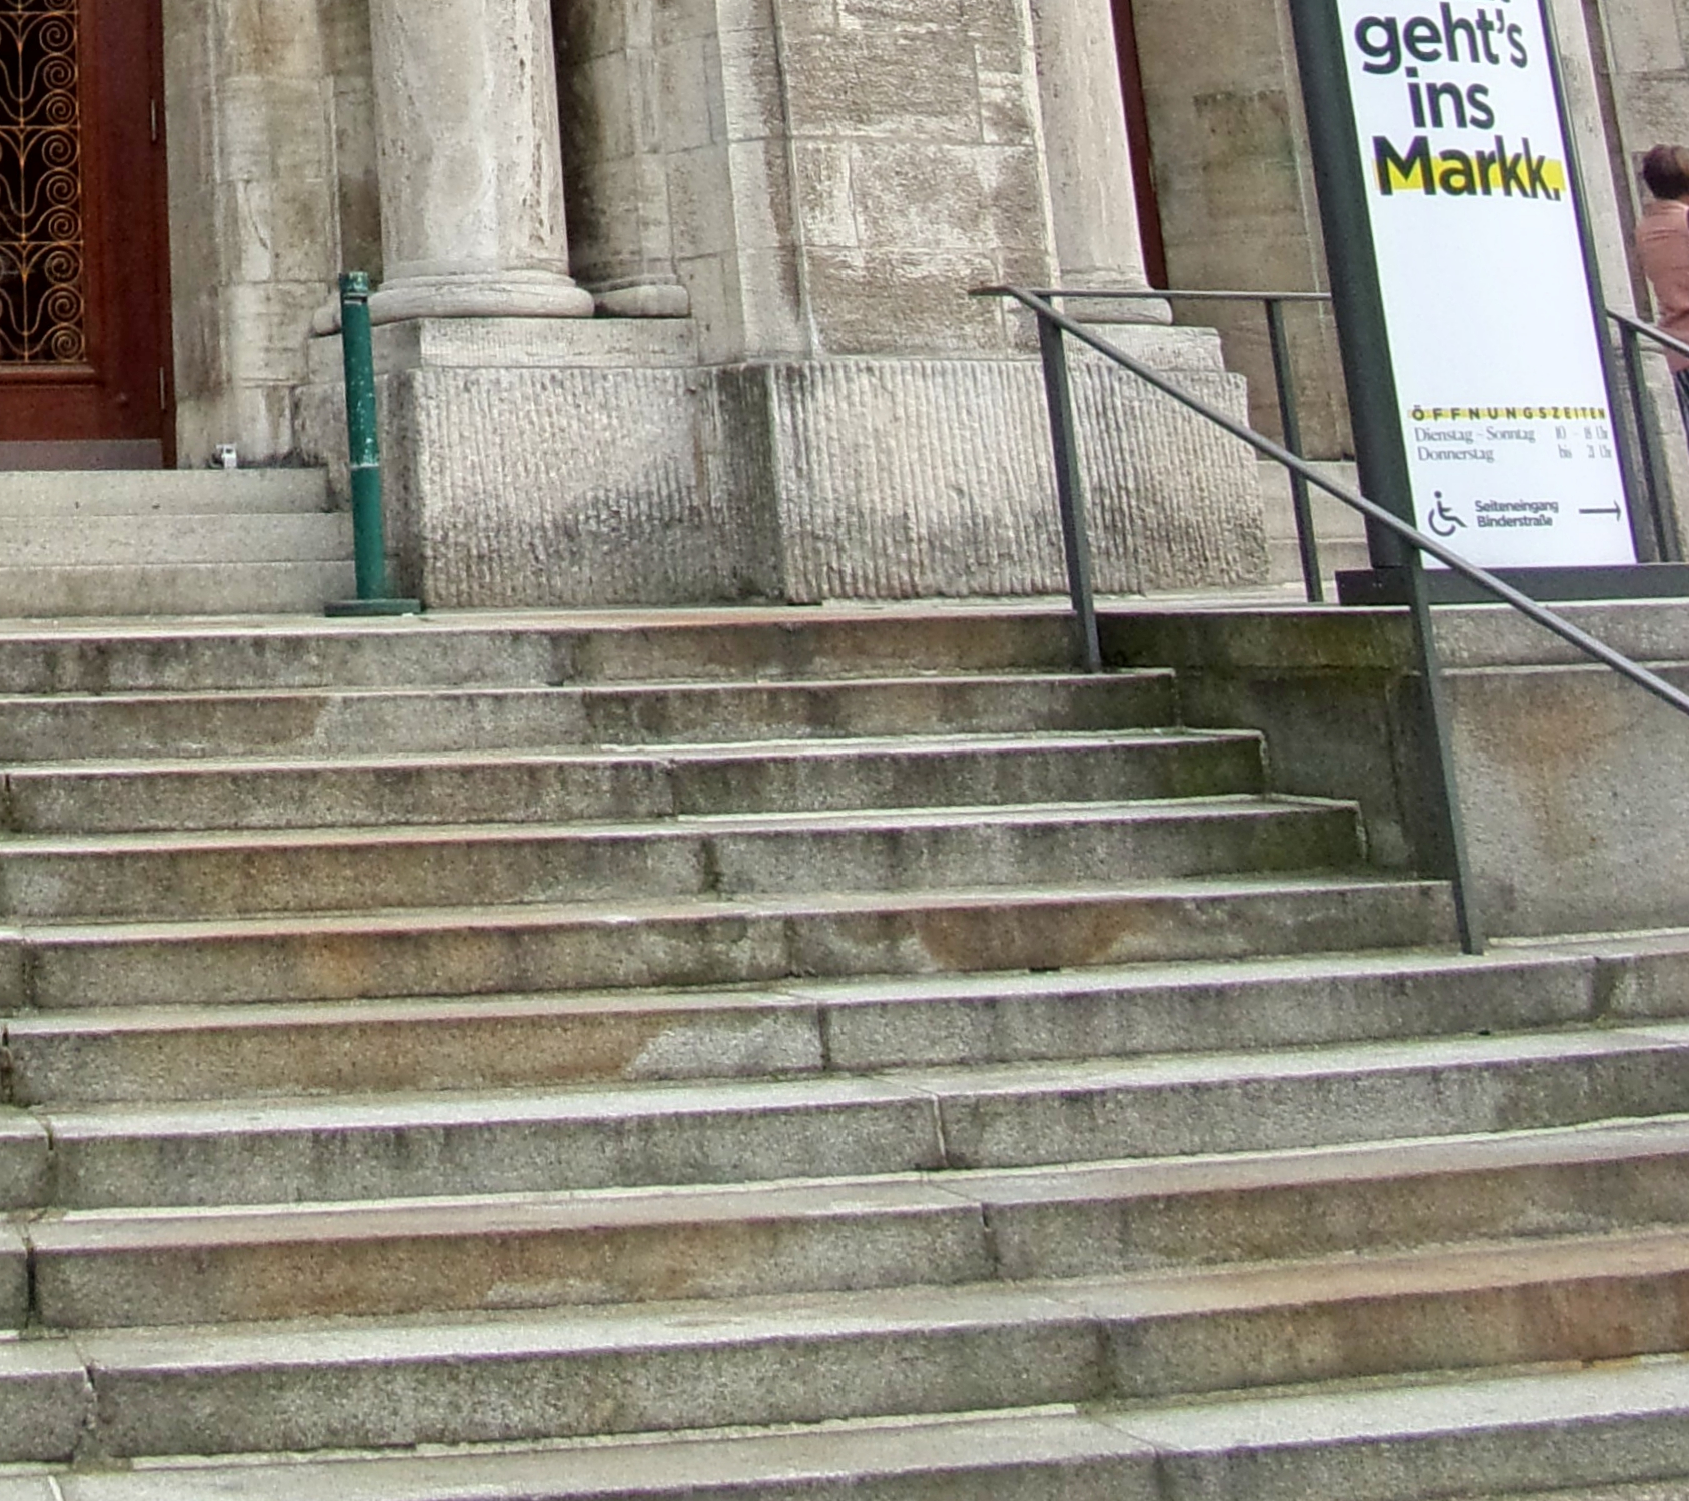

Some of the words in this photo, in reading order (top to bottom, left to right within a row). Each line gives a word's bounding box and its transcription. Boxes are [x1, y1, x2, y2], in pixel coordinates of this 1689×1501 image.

[1405, 66, 1495, 130] ins
[1372, 135, 1562, 202] Markk.
[1411, 405, 1606, 421] ÖFFNUNGSZEITEN
[1415, 427, 1474, 444] Dienstag
[1486, 426, 1536, 443] Sonntag
[1418, 446, 1495, 463] Donnerstag
[1558, 445, 1572, 459] bis
[1474, 500, 1559, 513] Seiteneingang
[1477, 514, 1553, 528] Binderstraße
